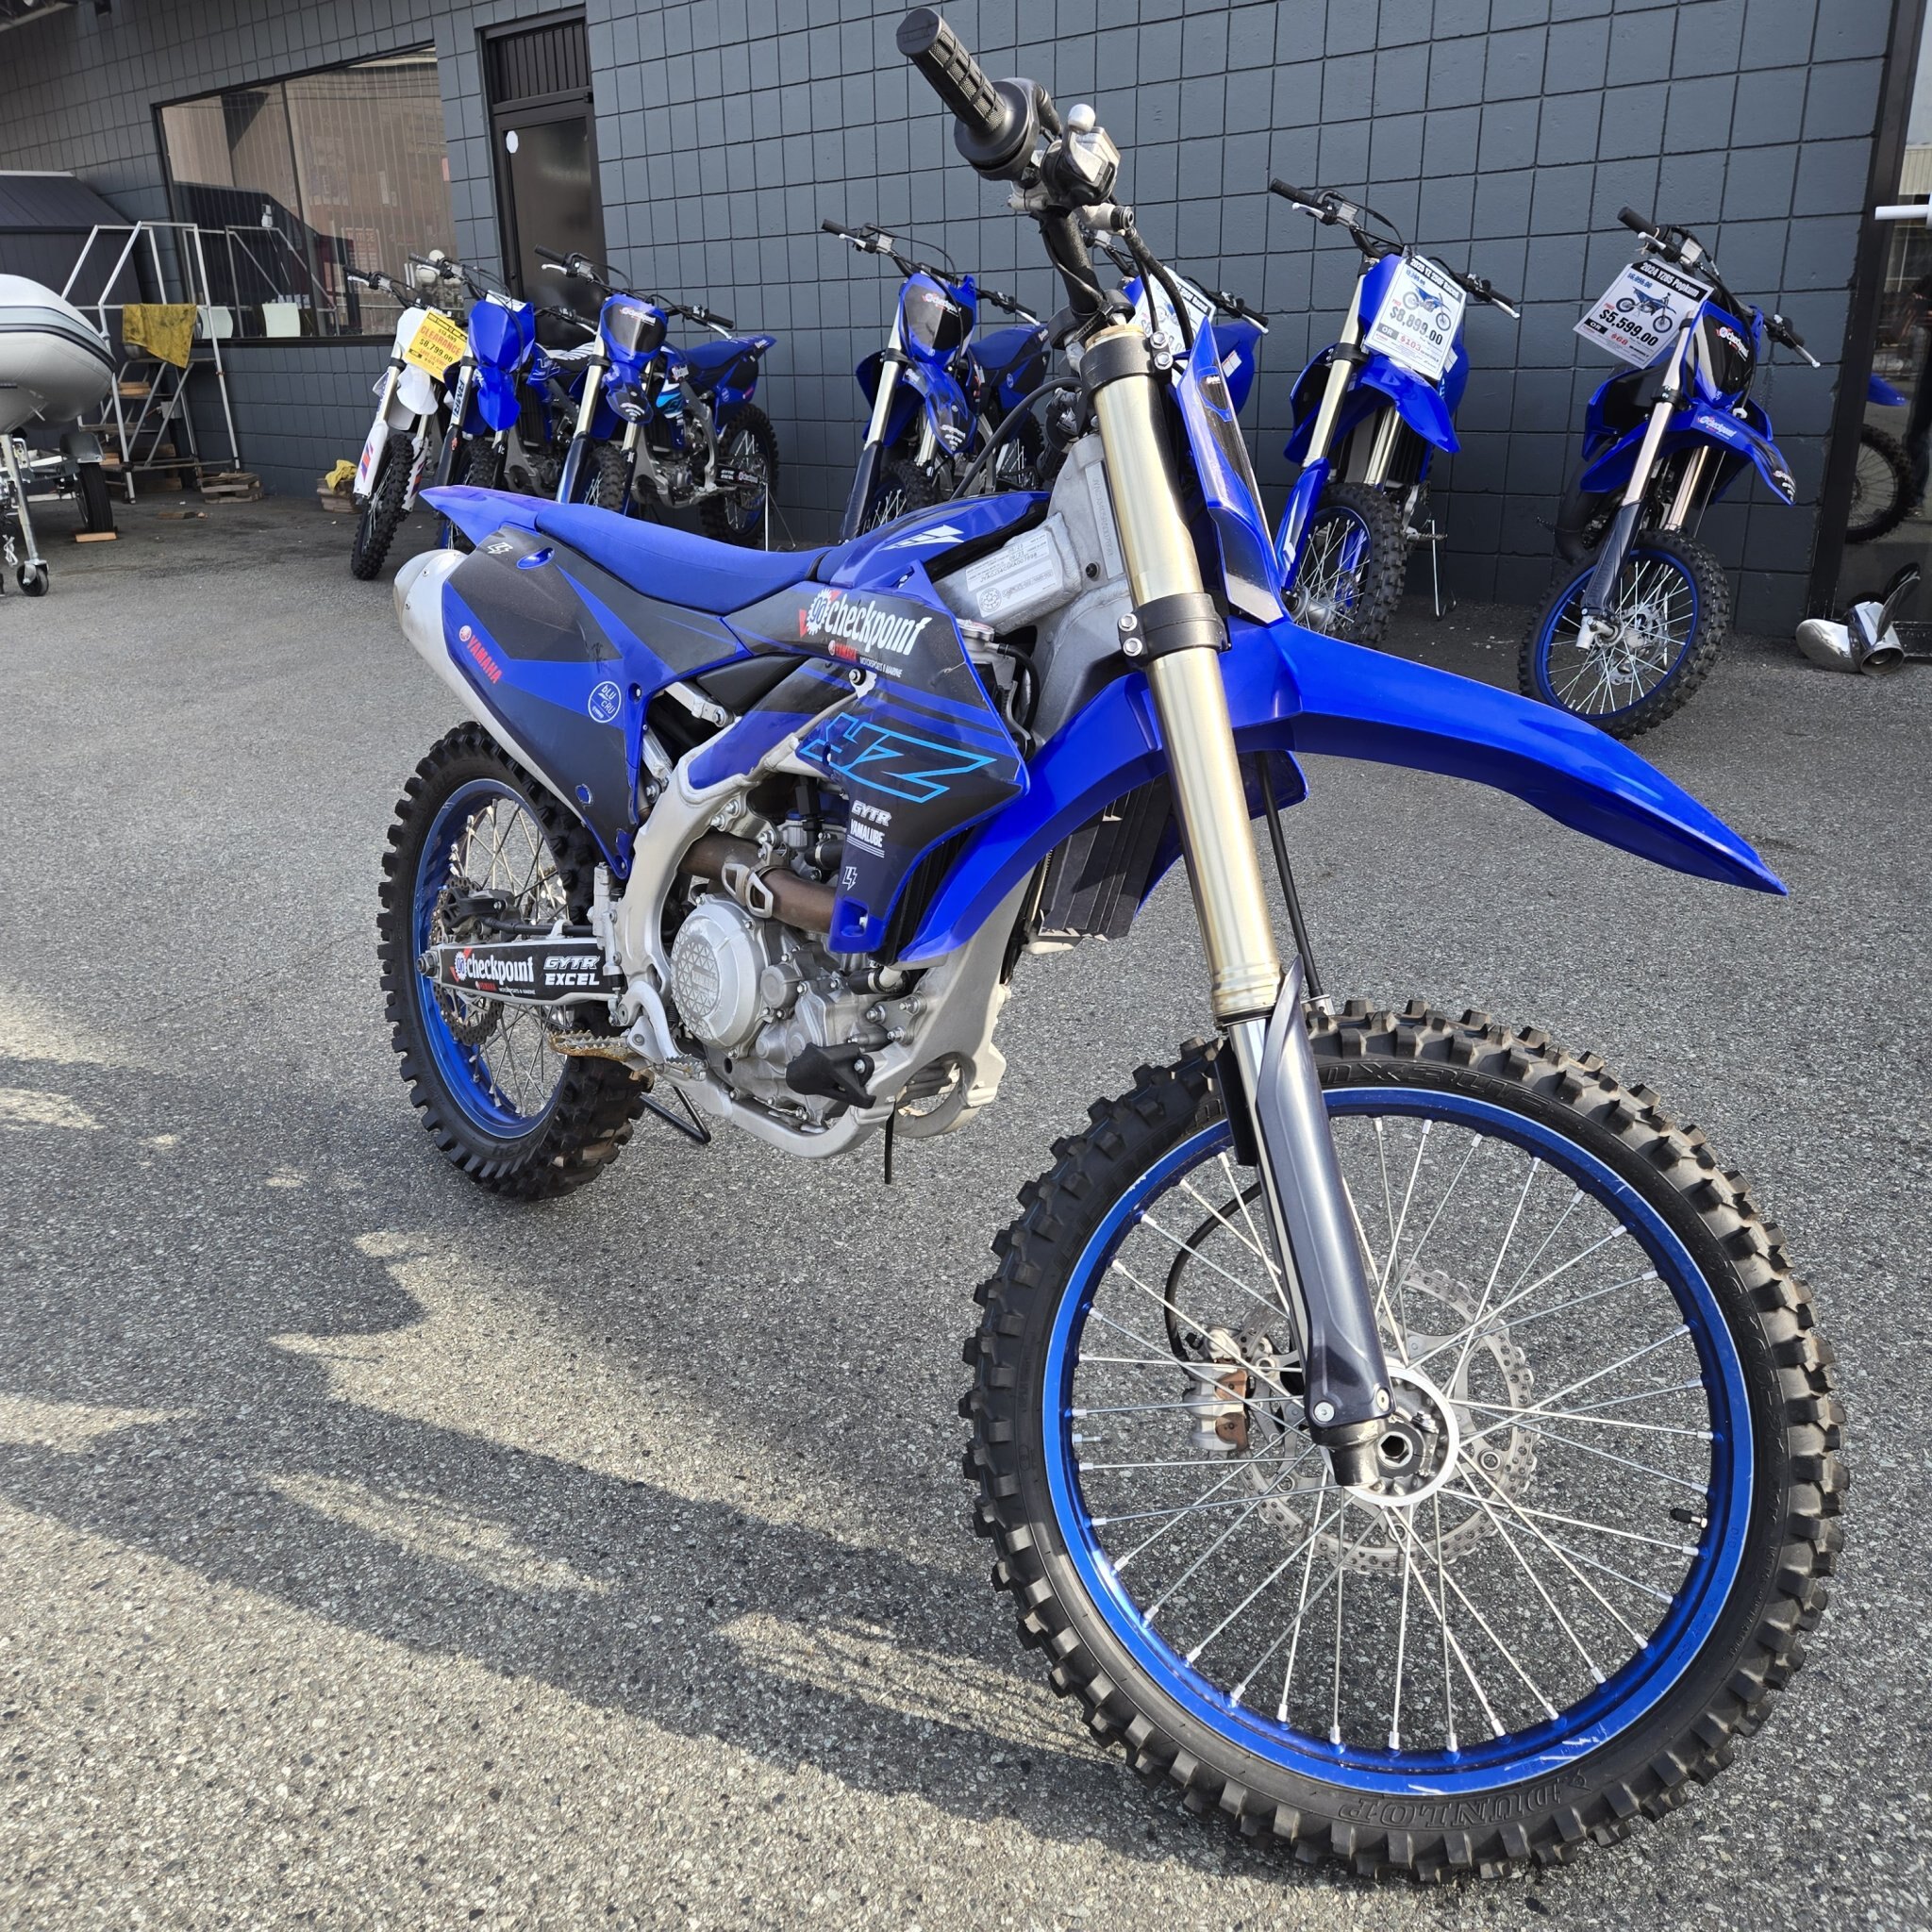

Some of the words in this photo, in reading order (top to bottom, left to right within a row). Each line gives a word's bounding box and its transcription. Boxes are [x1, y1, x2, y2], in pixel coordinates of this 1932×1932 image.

[1640, 263, 1657, 275] 2024
[1657, 271, 1673, 283] YZ85
[1672, 277, 1699, 297] Popkum
[421, 325, 461, 356] CLEARANCE
[1390, 307, 1443, 345] $8,899.00
[1599, 308, 1658, 347] $5,599.00
[824, 593, 932, 656] checkpoint
[466, 635, 503, 684] YAMAHA
[851, 800, 891, 826] GYTR
[850, 819, 885, 848] YAMALUBE
[466, 955, 535, 985] checkpoint
[543, 956, 600, 970] GYTR
[545, 973, 600, 986] EXCEL
[1338, 1775, 1562, 1829] DUNLOP
